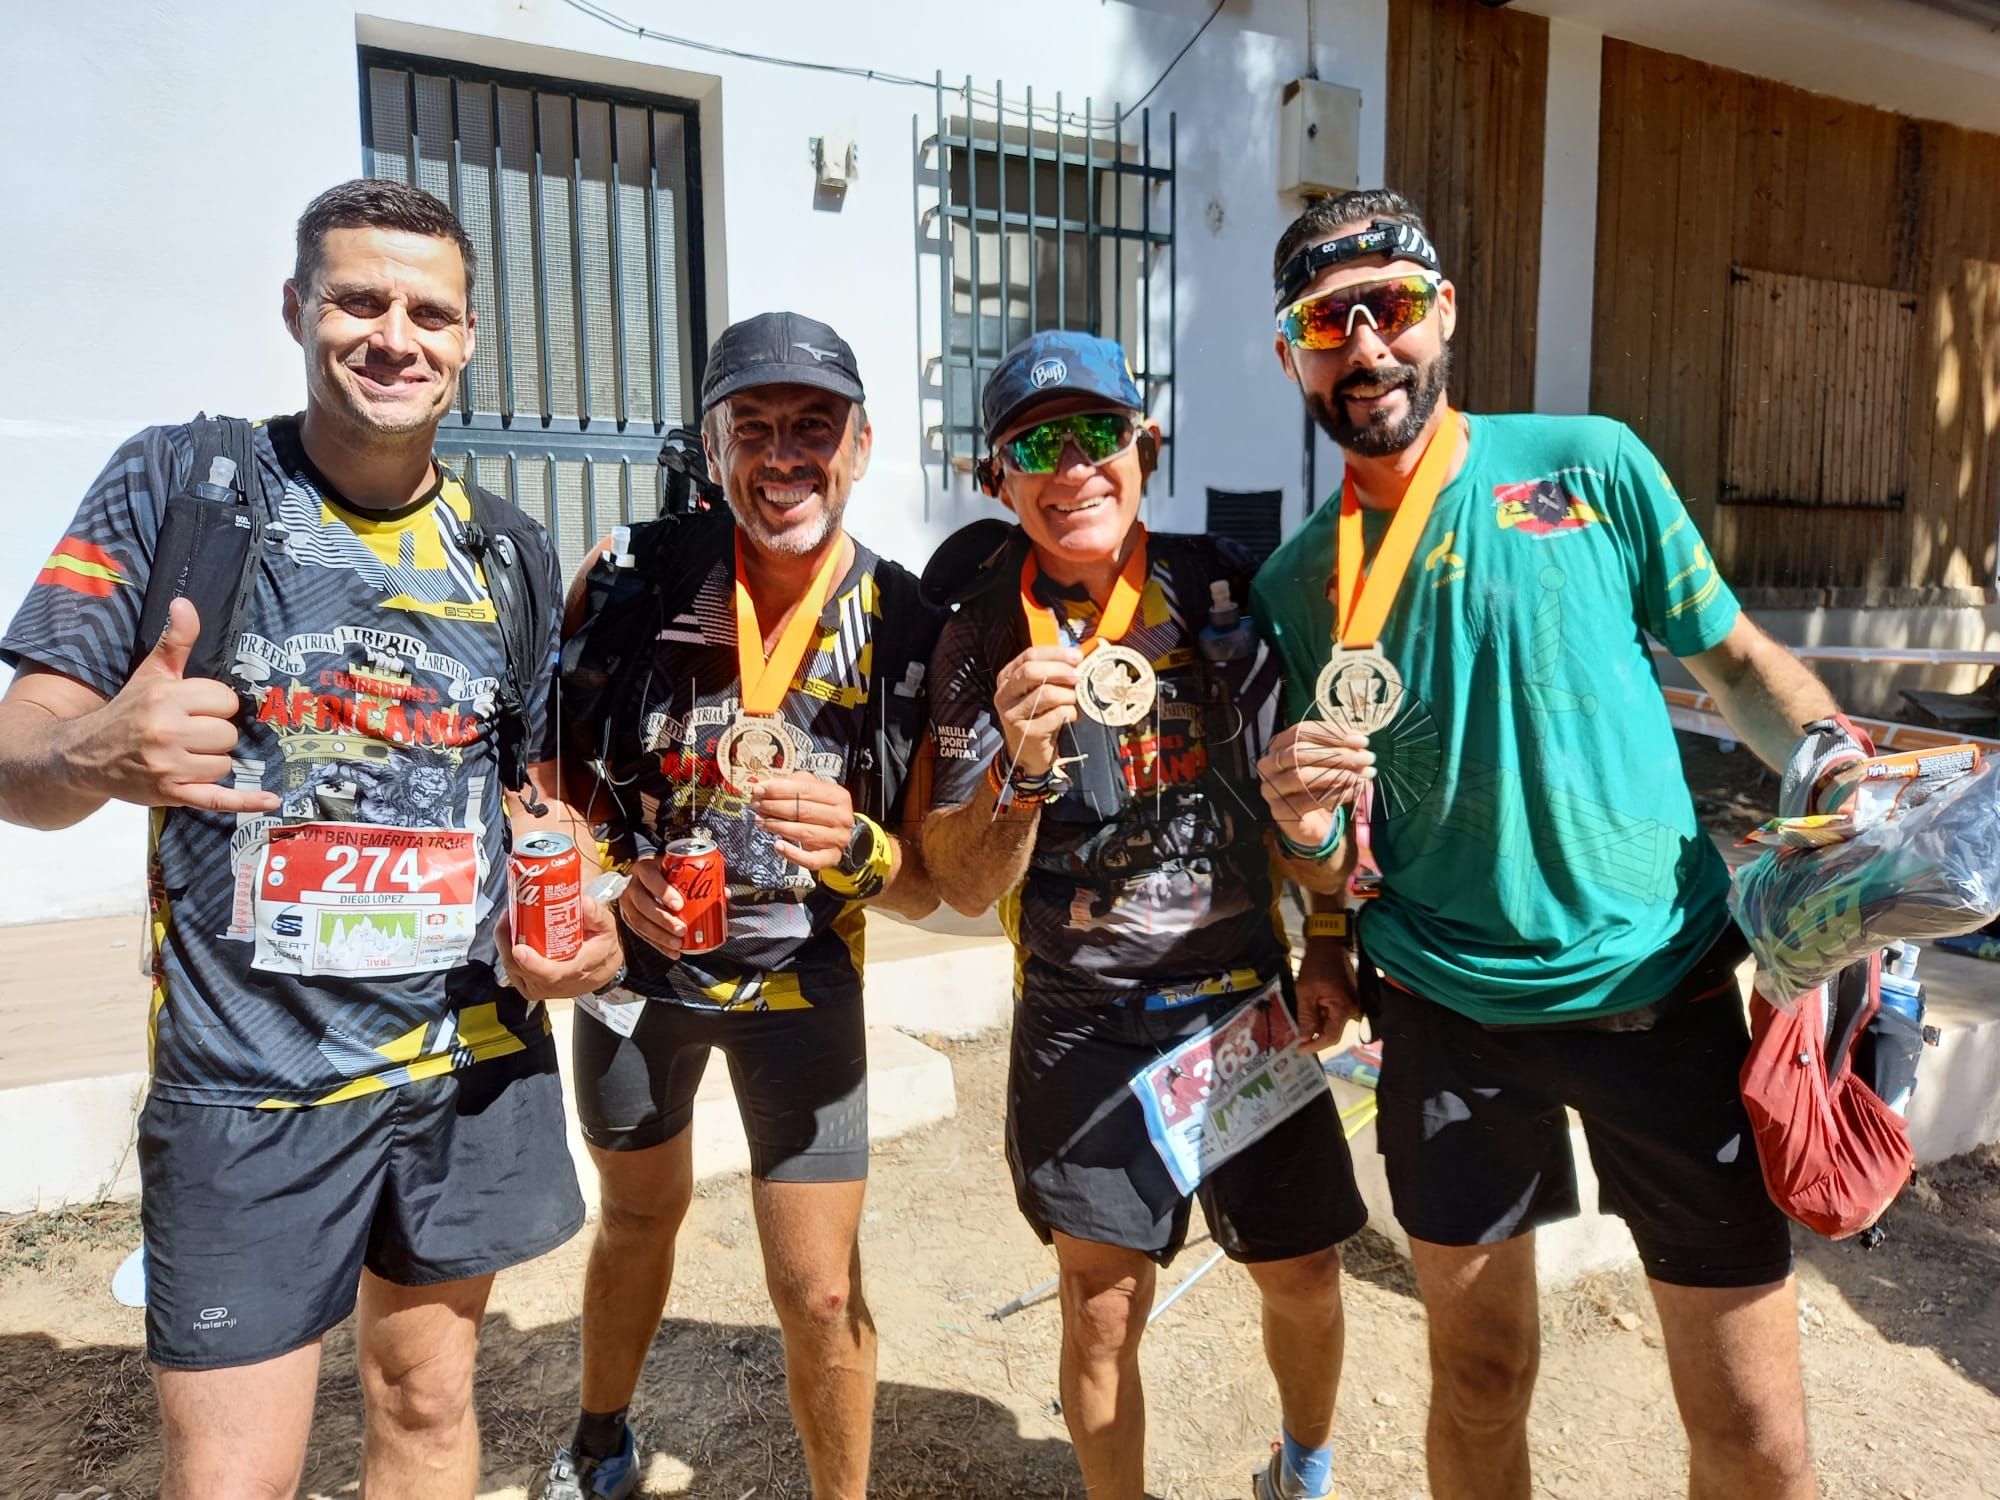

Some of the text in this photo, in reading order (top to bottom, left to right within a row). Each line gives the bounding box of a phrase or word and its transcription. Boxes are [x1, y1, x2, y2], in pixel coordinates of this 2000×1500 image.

[1035, 365, 1062, 386] Buff
[340, 628, 421, 656] LIBERIS
[256, 686, 480, 746] AFRICANUS
[938, 725, 978, 740] MELILLA
[940, 737, 969, 749] SPORT
[940, 747, 978, 760] CAPITAL
[231, 822, 252, 860] NON
[324, 829, 424, 849] BENEMÉRITA
[321, 845, 423, 893] 274
[340, 894, 370, 904] DIEGO
[1193, 1025, 1259, 1097] 363
[193, 1317, 237, 1331] Kalenji
